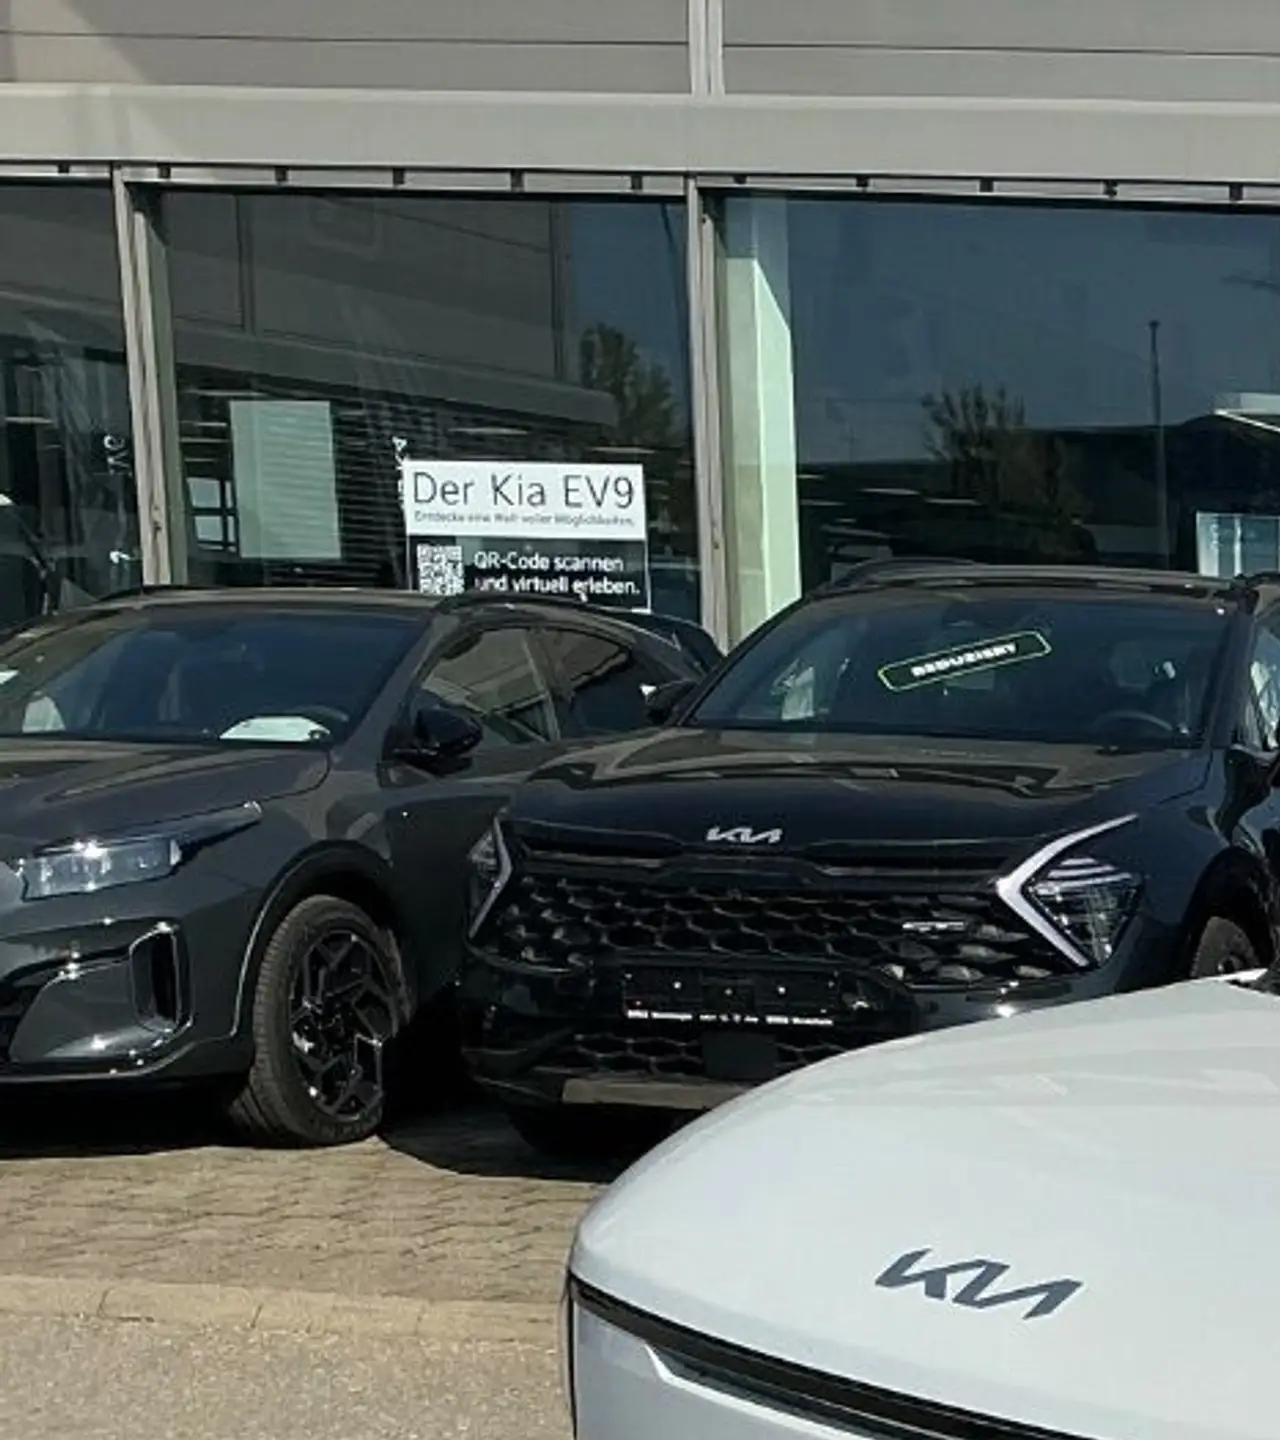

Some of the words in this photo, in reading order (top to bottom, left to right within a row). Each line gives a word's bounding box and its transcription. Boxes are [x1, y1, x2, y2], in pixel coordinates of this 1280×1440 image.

[413, 471, 475, 505] Der
[491, 474, 547, 507] Kia
[563, 474, 635, 509] EV9
[474, 551, 549, 572] QR-Code
[553, 556, 624, 573] scannen
[475, 575, 509, 592] und
[512, 575, 569, 592] virtuell
[572, 577, 640, 595] erleben.
[706, 825, 782, 843] KIA
[875, 1248, 1084, 1320] KIA
